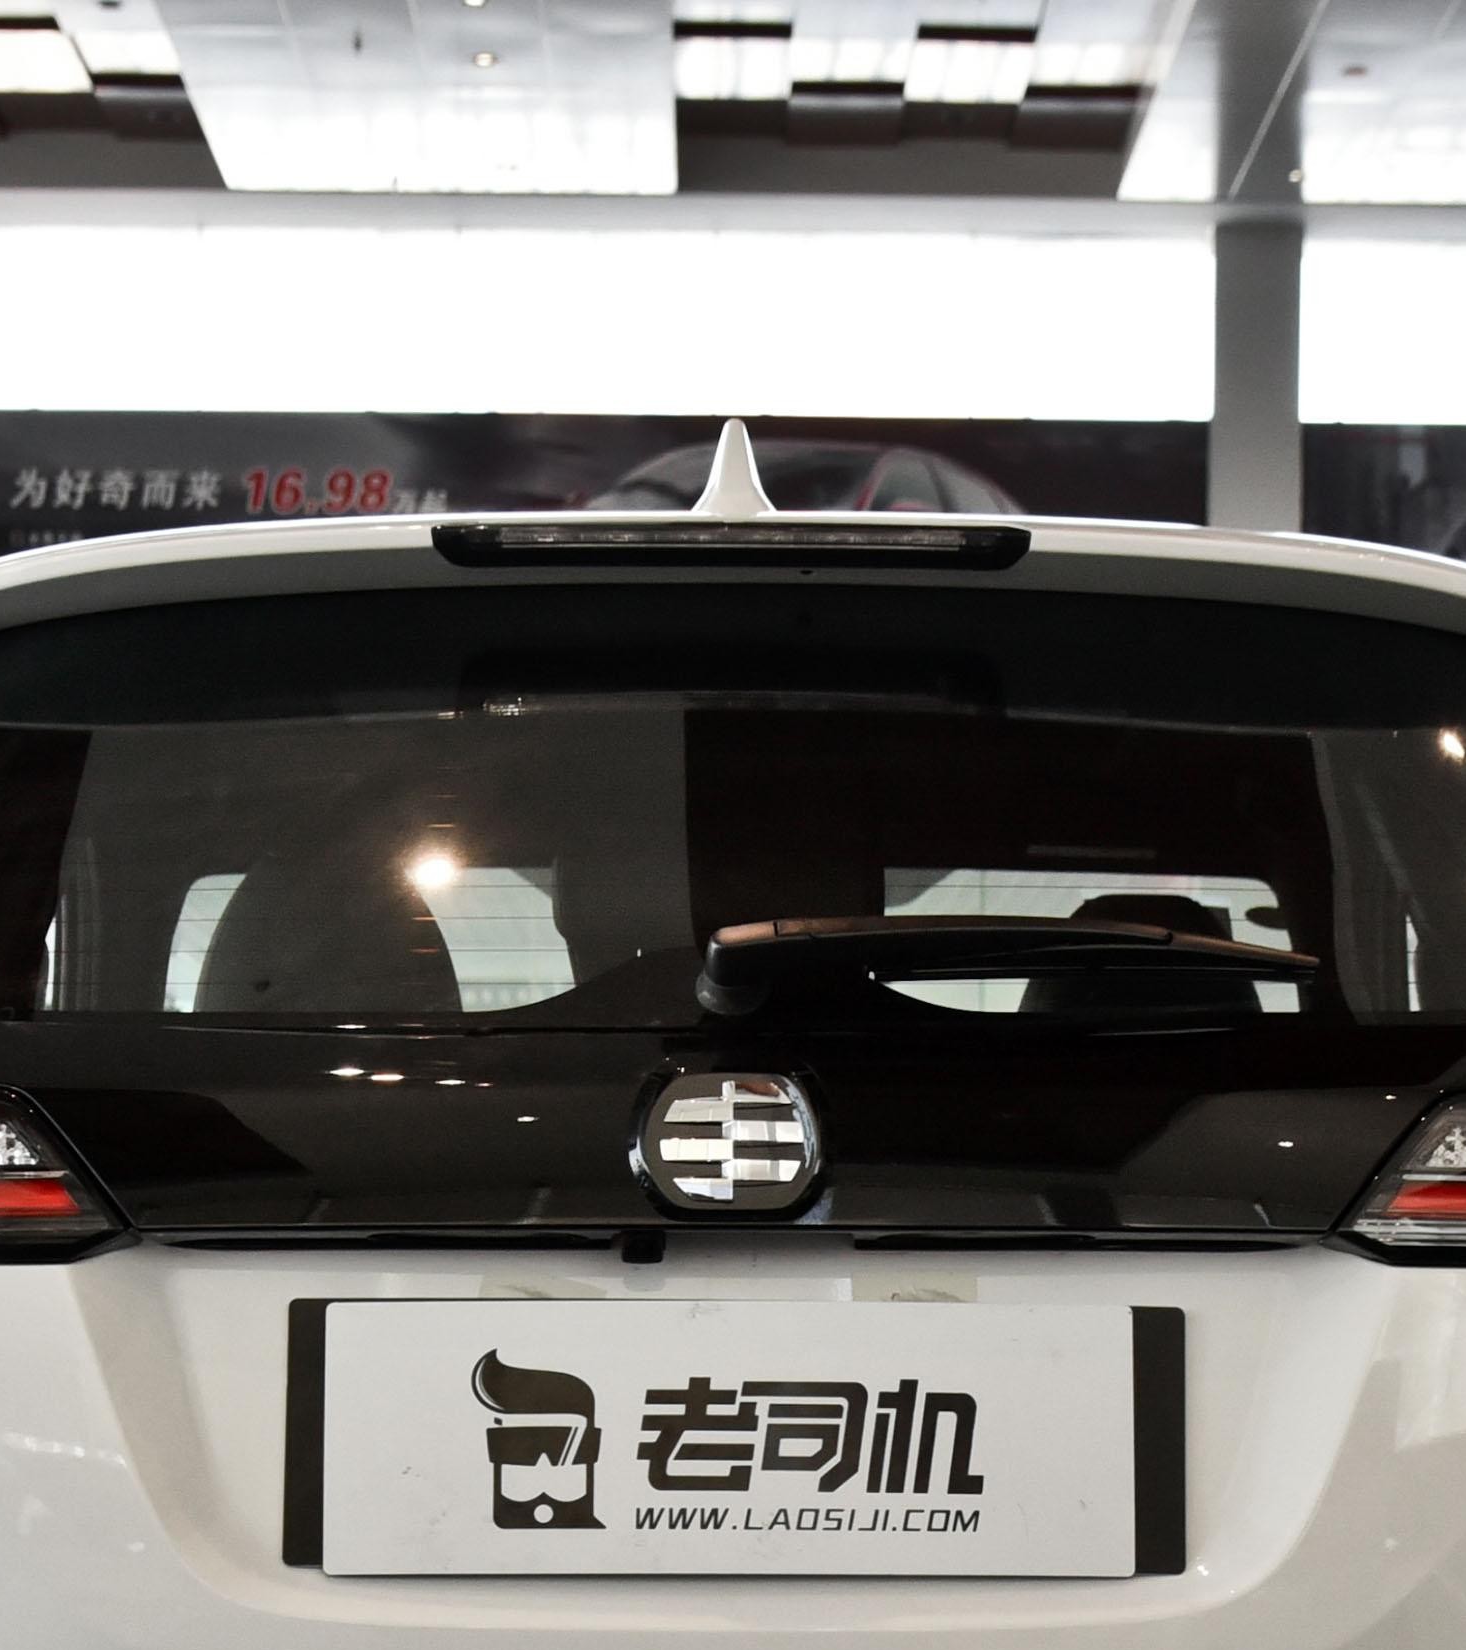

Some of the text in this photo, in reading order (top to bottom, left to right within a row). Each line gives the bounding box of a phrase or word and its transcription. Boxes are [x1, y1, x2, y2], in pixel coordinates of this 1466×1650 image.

[9, 467, 221, 510] 为好奇而来
[636, 1376, 985, 1495] 老司机
[634, 1506, 981, 1533] WWW.LAOSIJI.COM
